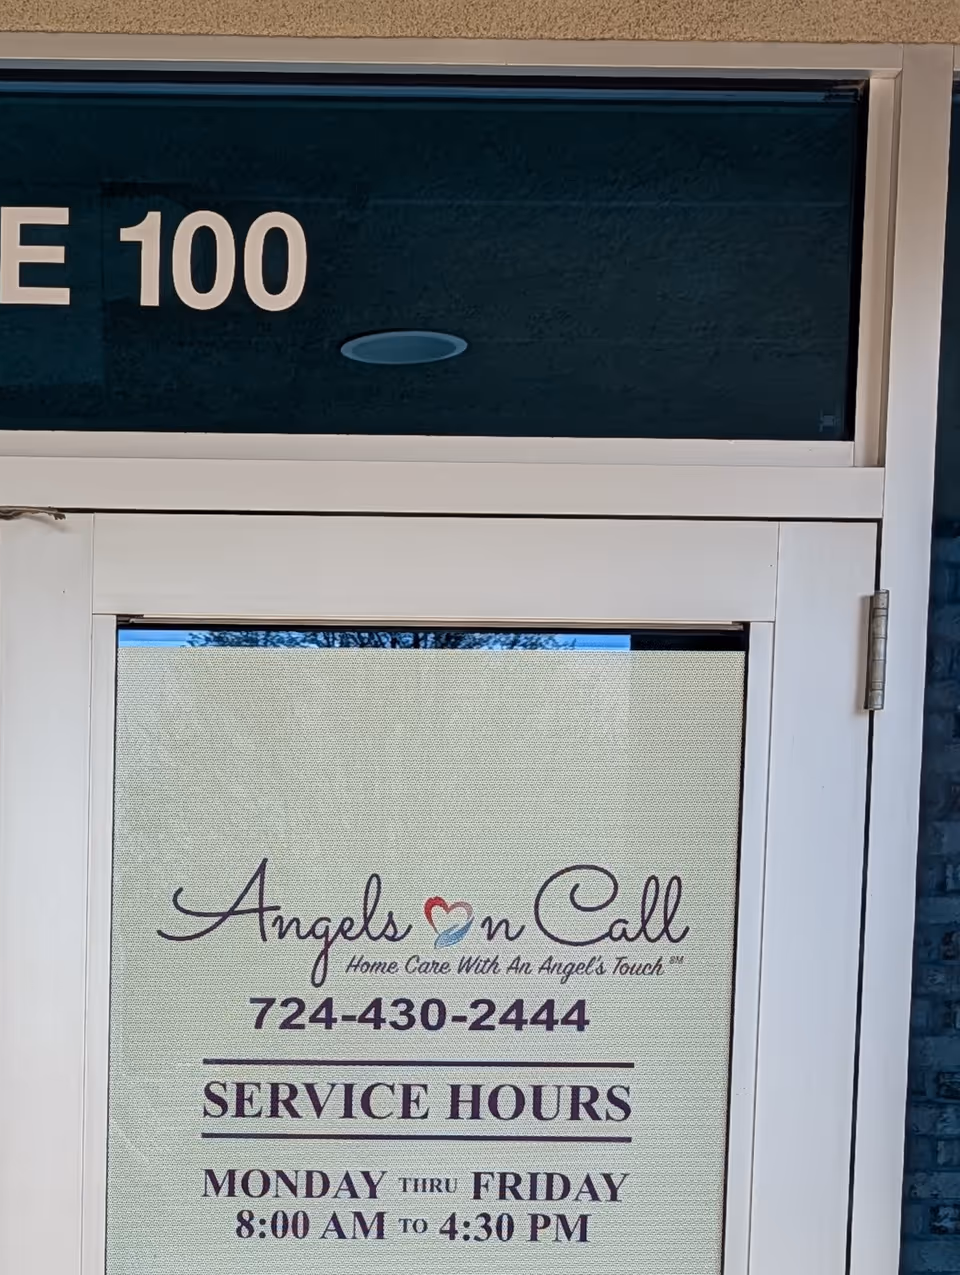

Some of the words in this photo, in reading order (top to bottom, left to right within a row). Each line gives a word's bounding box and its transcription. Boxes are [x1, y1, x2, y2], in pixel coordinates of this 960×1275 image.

[120, 210, 307, 311] 100
[157, 858, 412, 987] Angels
[535, 864, 689, 946] Call
[346, 956, 398, 975] Home
[405, 956, 451, 975] Care
[458, 956, 500, 975] With
[507, 957, 532, 975] An
[538, 957, 605, 984] Angel's
[612, 957, 664, 977] Touch
[250, 997, 590, 1031] 724-430-2444
[203, 1081, 429, 1119] SERVICE
[446, 1084, 632, 1122] HOURS
[202, 1169, 387, 1200] MONDAY
[399, 1177, 458, 1193] THRU
[471, 1171, 630, 1202] FRIDAY
[236, 1209, 309, 1239] 8:00
[320, 1212, 387, 1240] AM
[398, 1218, 428, 1235] TO
[439, 1213, 513, 1242] 4:30
[527, 1214, 592, 1242] PM
